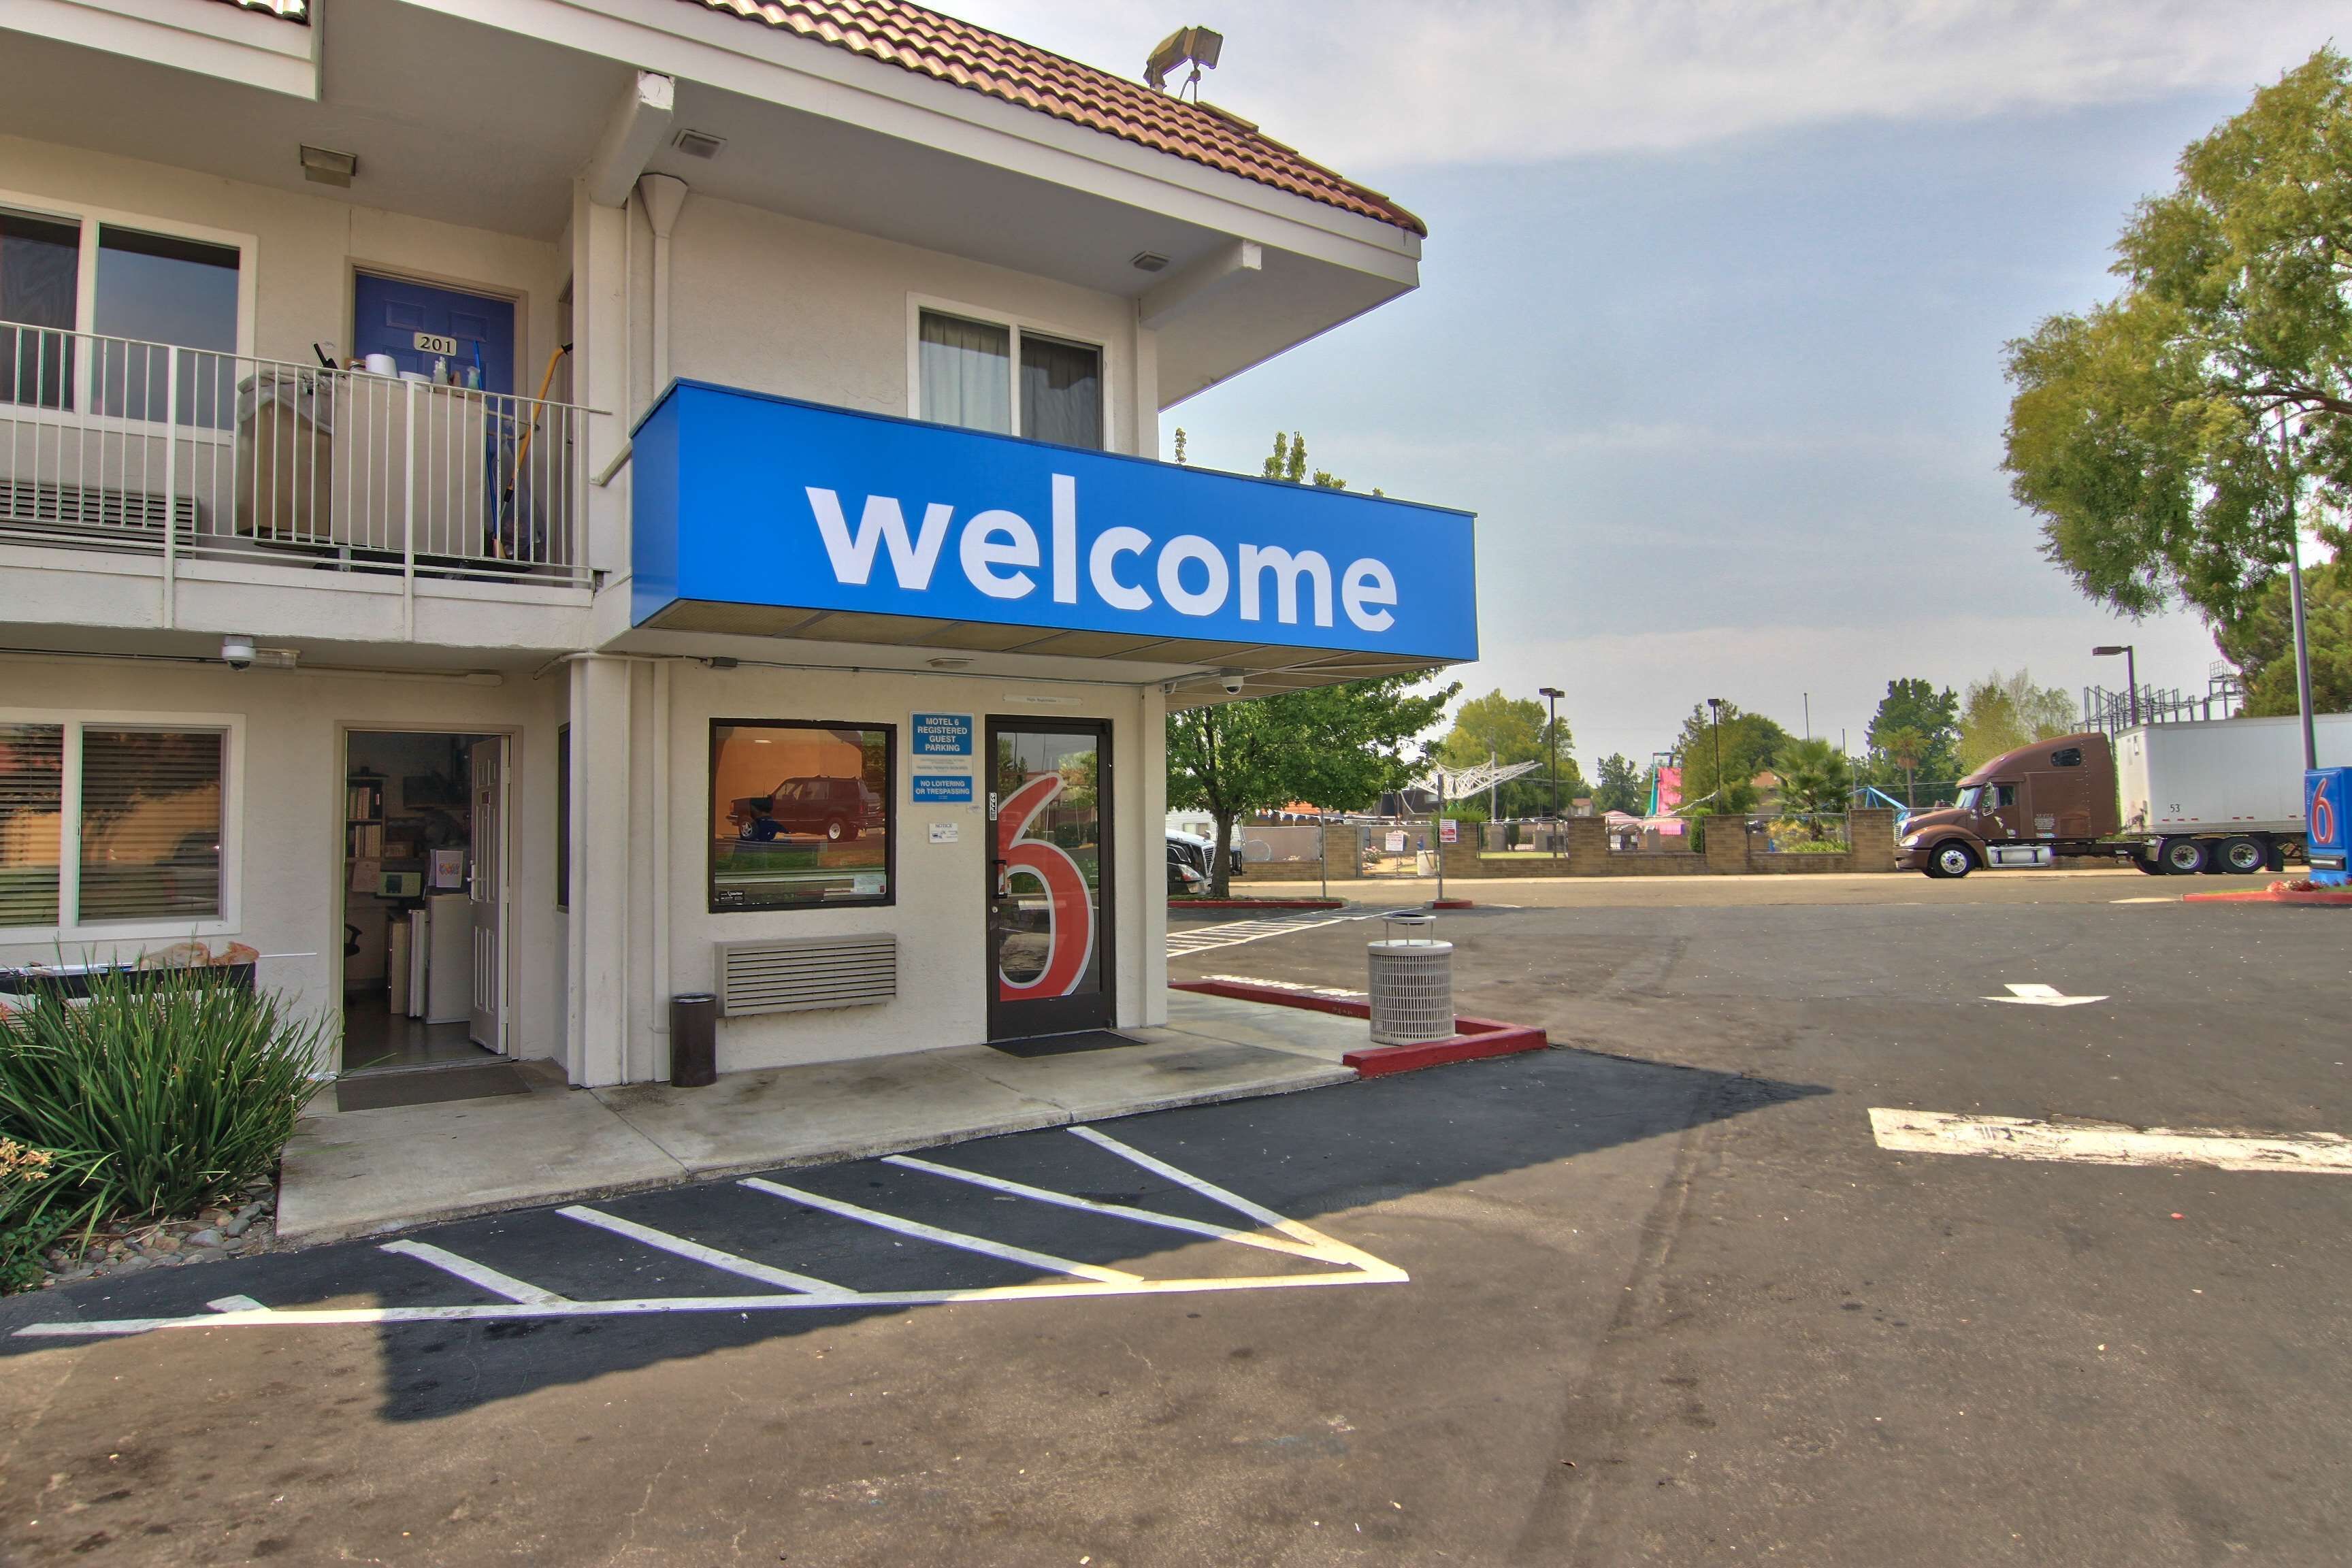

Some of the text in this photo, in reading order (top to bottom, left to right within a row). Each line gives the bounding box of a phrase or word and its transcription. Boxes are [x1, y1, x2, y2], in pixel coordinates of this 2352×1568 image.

[420, 336, 451, 353] 201
[805, 473, 1398, 632] welcome
[926, 717, 953, 725] MOTEL
[917, 726, 967, 734] REGISTERED
[929, 735, 956, 743] GUEST
[2170, 804, 2180, 813] 53
[2310, 777, 2333, 845] 6
